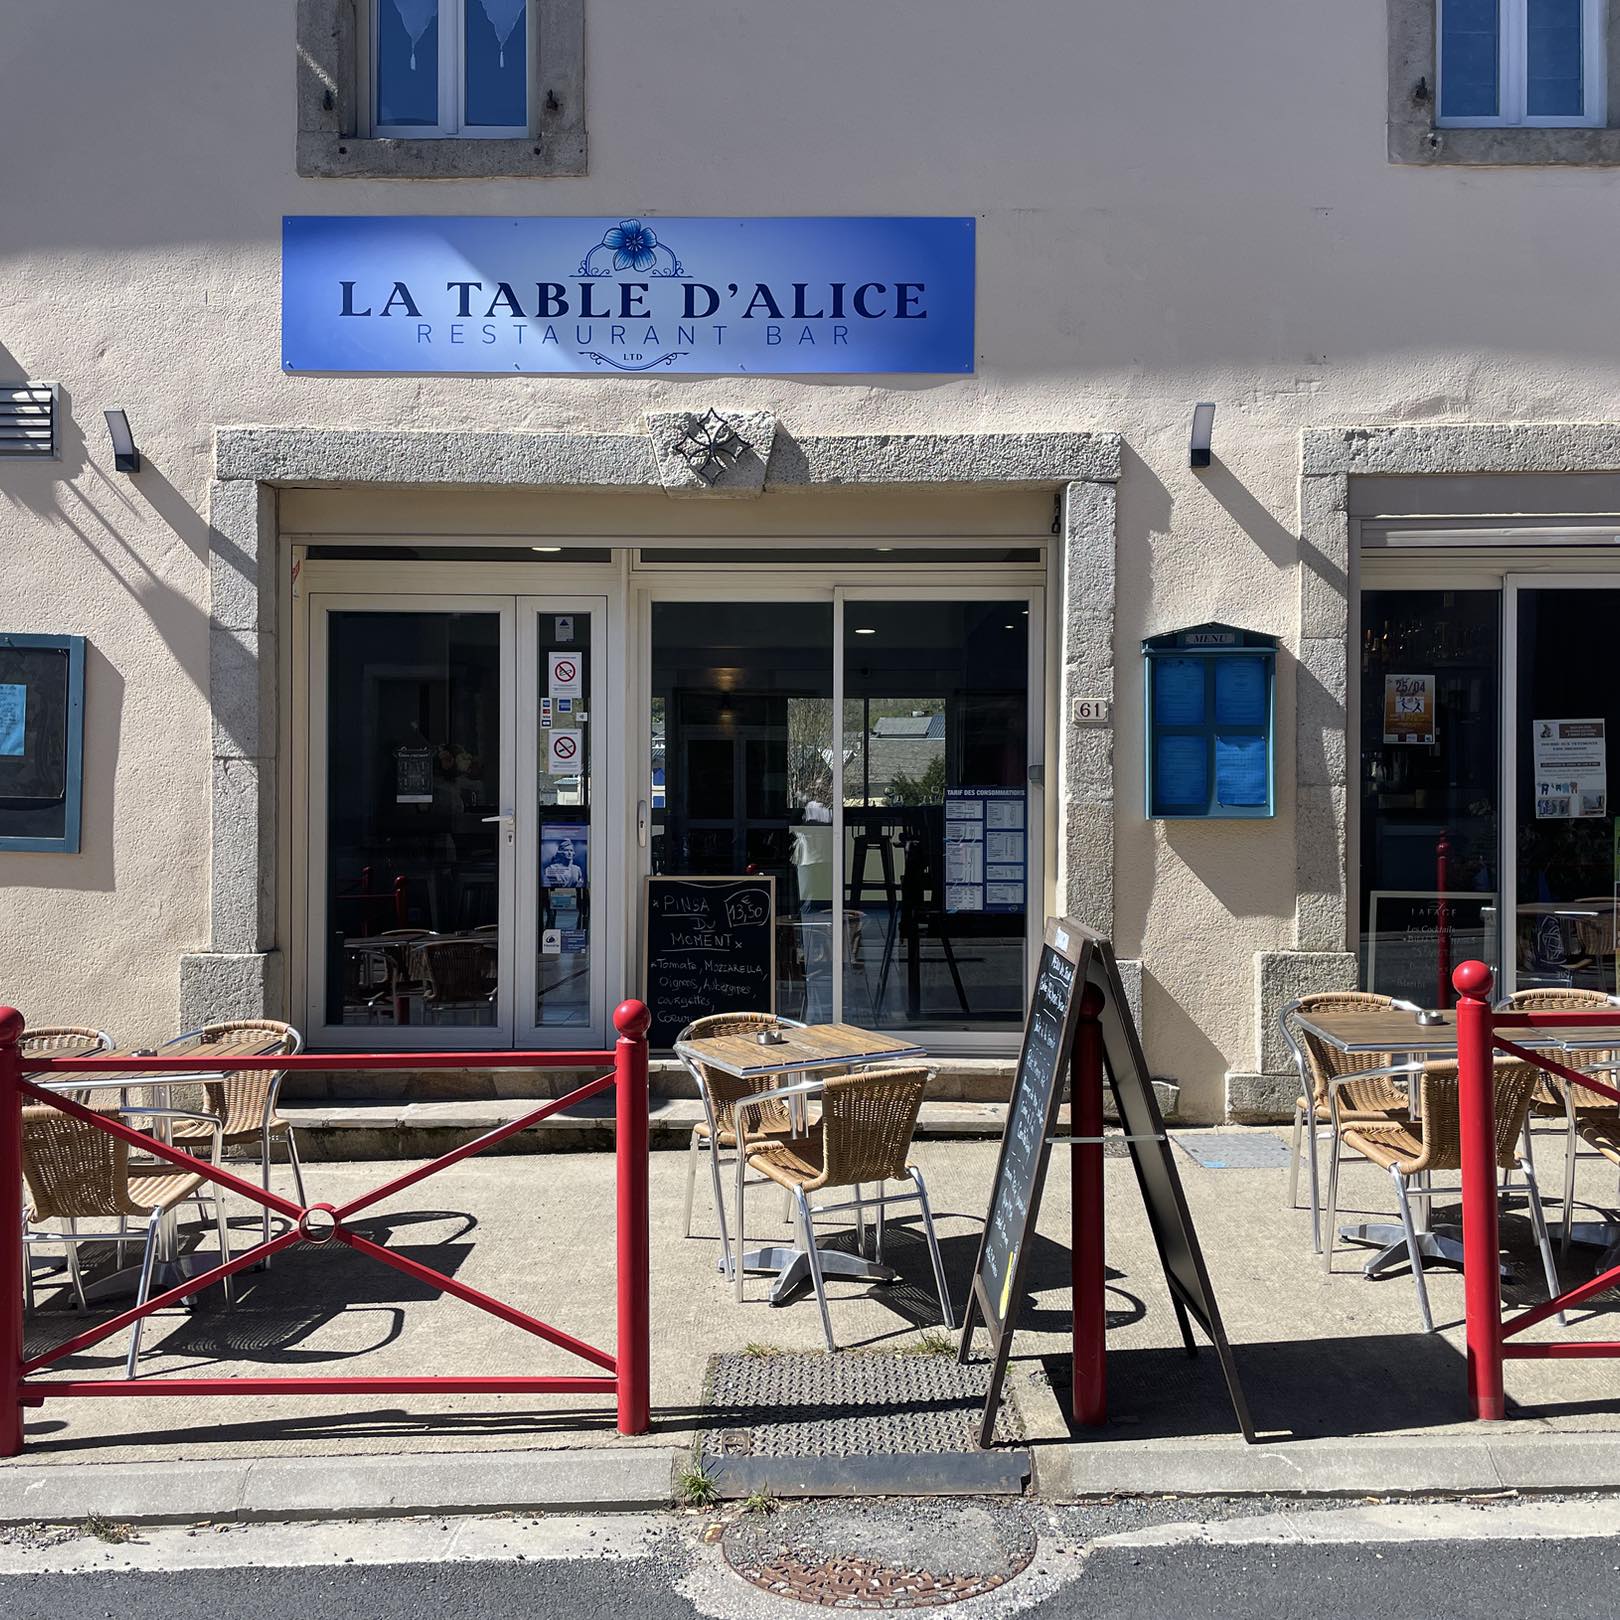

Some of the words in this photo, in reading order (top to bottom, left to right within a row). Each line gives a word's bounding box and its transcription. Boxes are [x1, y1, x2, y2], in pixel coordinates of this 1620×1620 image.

[338, 280, 423, 318] LA
[446, 281, 652, 319] TABLE
[681, 282, 928, 319] D'ALICE
[416, 323, 728, 346] RESTAURANT
[766, 325, 849, 346] BAR
[623, 353, 643, 361] LTD
[1193, 633, 1227, 643] MENU
[1395, 680, 1426, 693] 25/04
[1079, 702, 1101, 718] 61
[663, 894, 710, 912] PINSA
[670, 933, 733, 947] MOMENT
